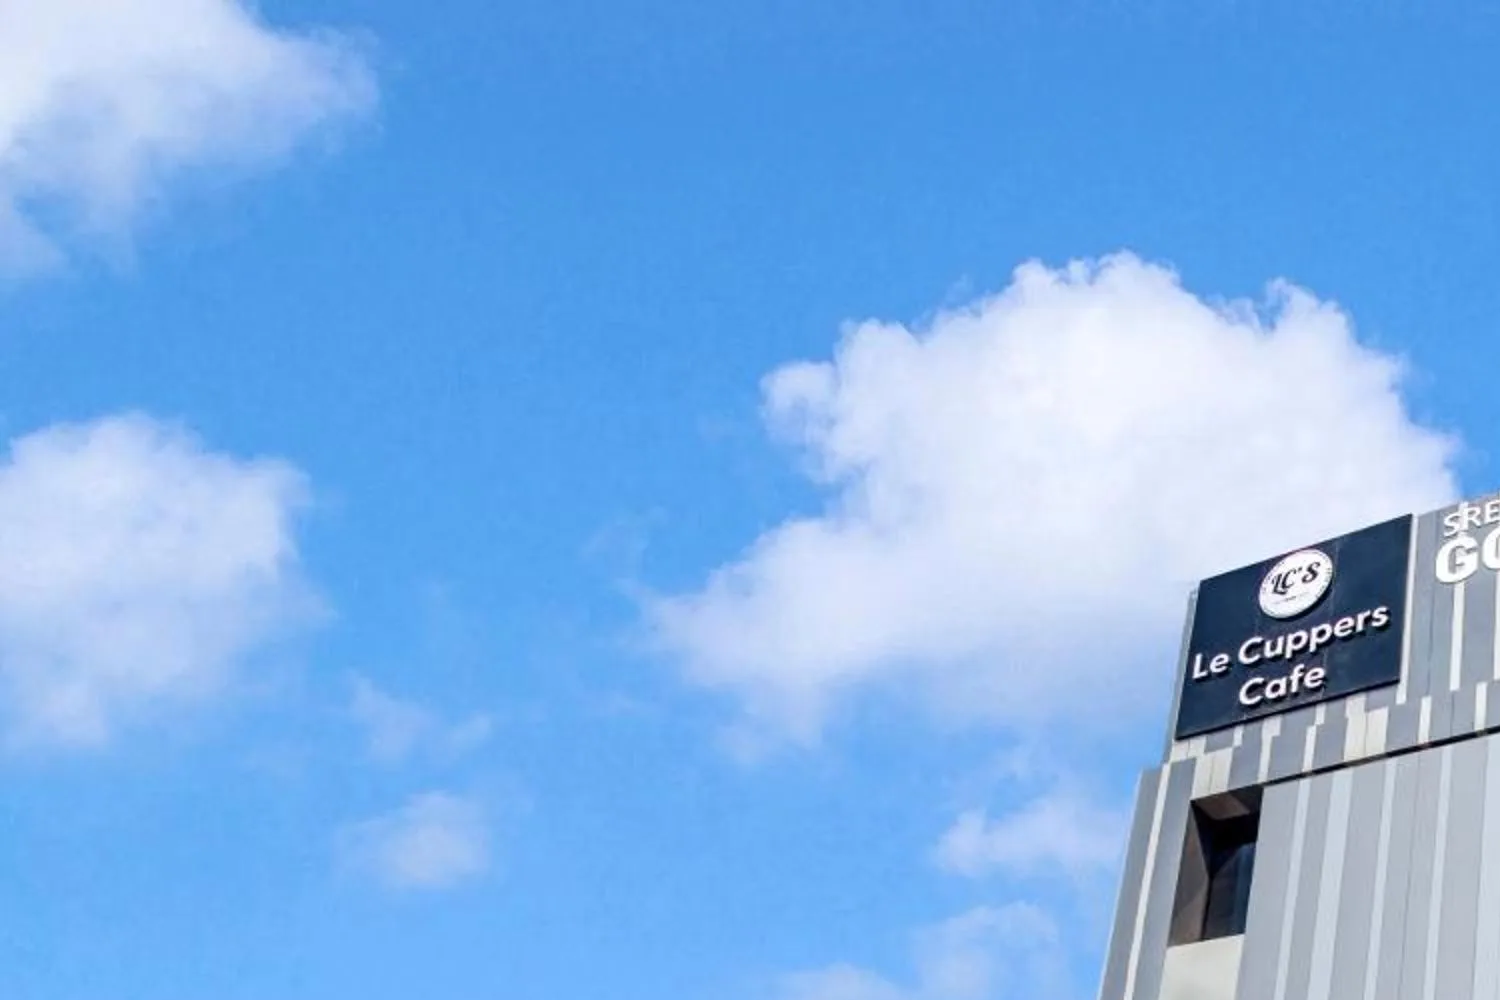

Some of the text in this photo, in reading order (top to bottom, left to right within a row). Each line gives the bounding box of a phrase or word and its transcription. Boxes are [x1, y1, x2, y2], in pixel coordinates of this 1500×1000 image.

[1192, 606, 1390, 679] Le Cuppers
[1238, 664, 1327, 706] Cafe
